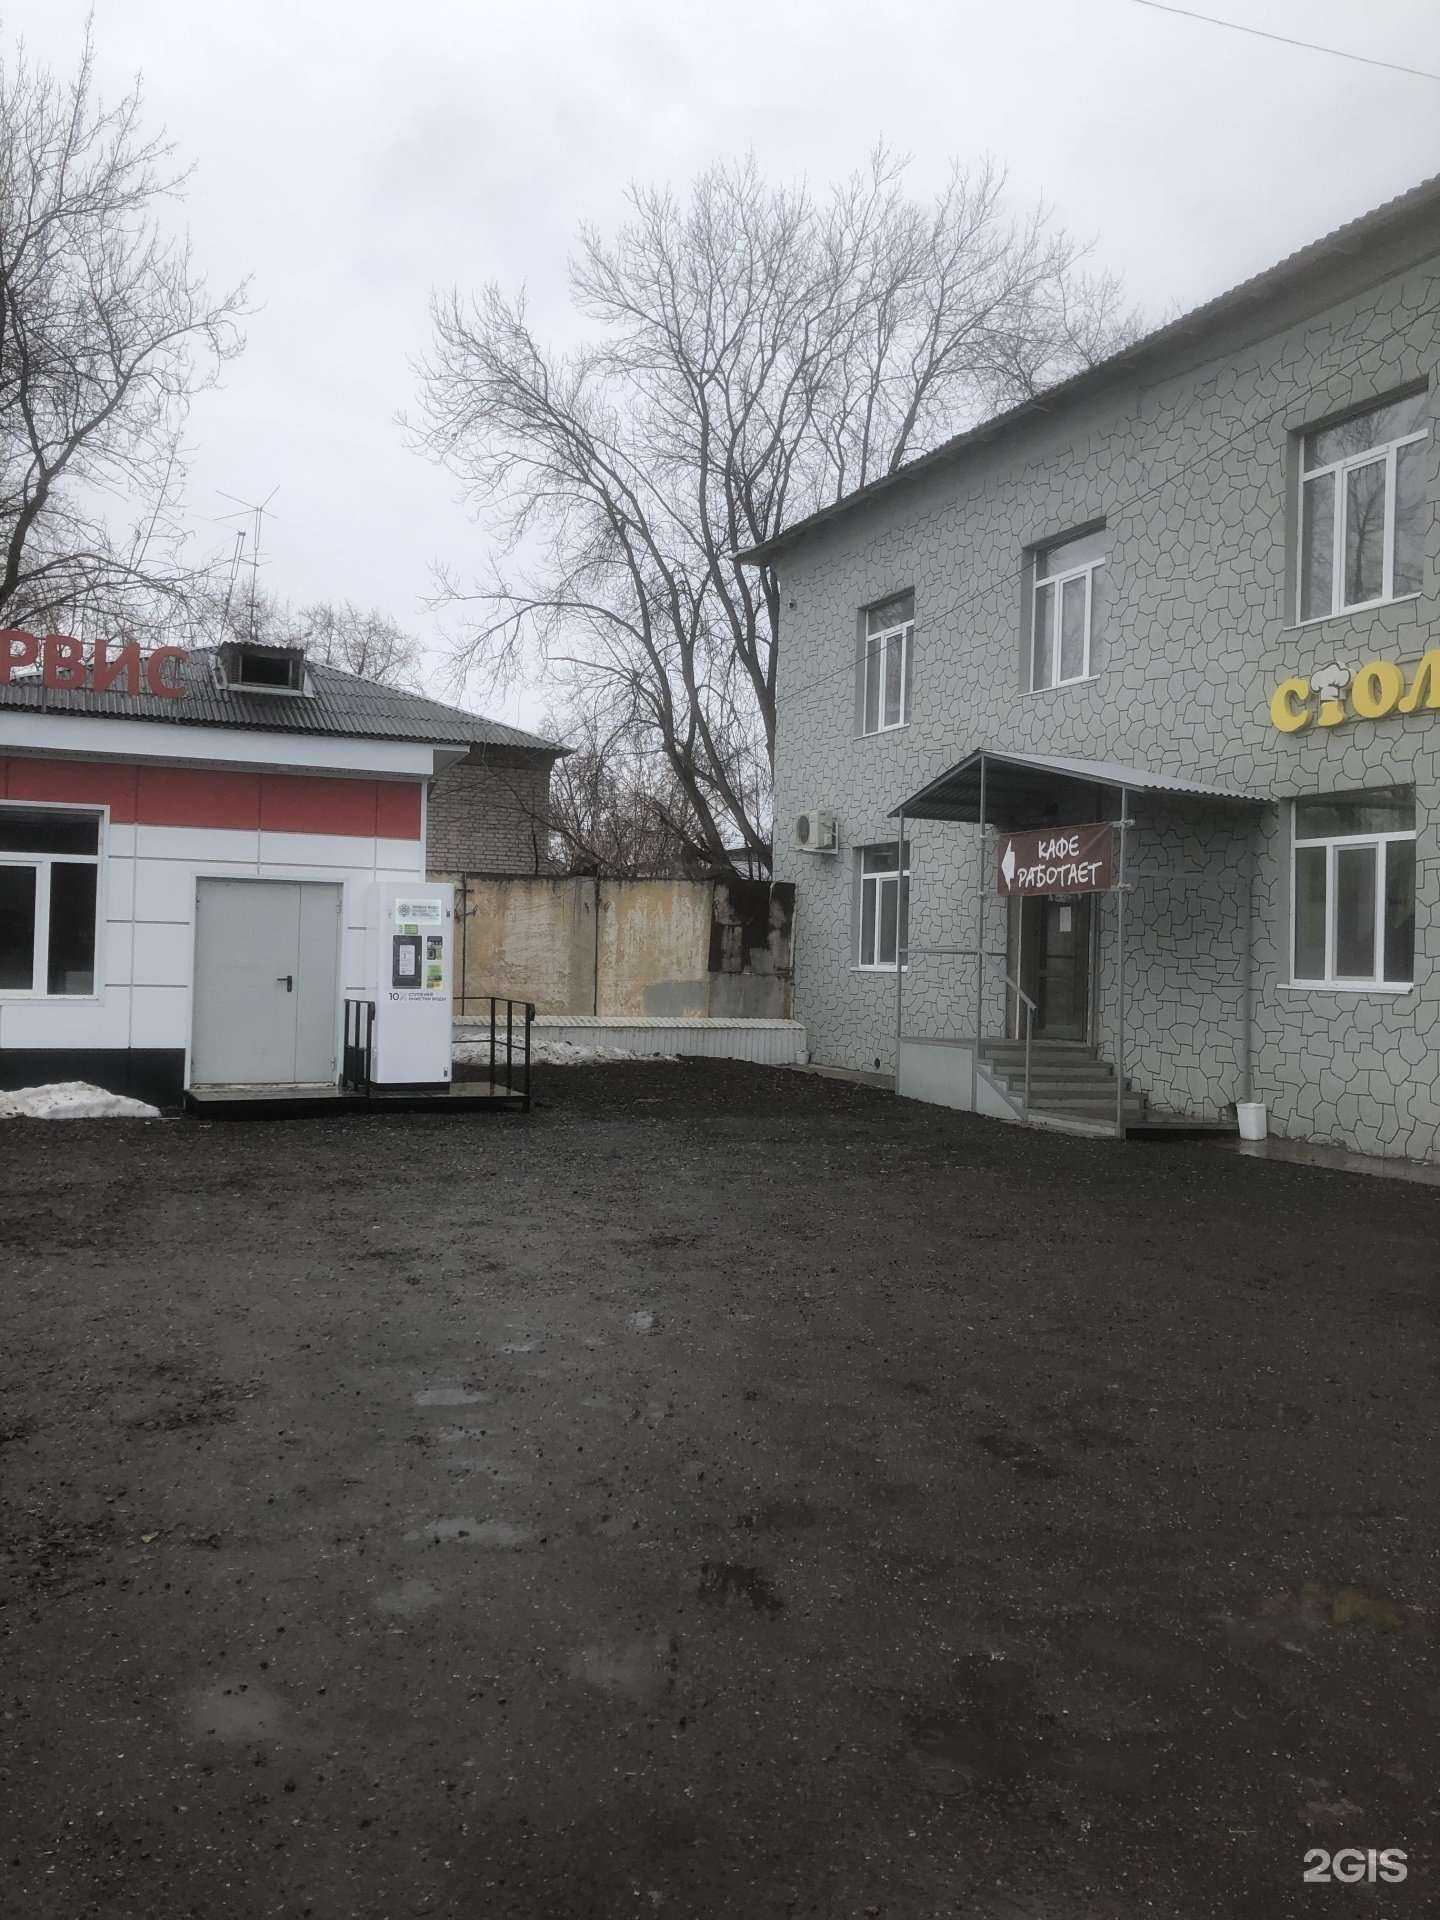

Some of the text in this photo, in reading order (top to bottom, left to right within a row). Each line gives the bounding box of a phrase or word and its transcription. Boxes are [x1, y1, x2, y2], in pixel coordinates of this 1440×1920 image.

[0, 629, 188, 699] РВИС
[1038, 835, 1080, 860] КАФЕ
[1018, 861, 1102, 888] РАБОТАЕТ
